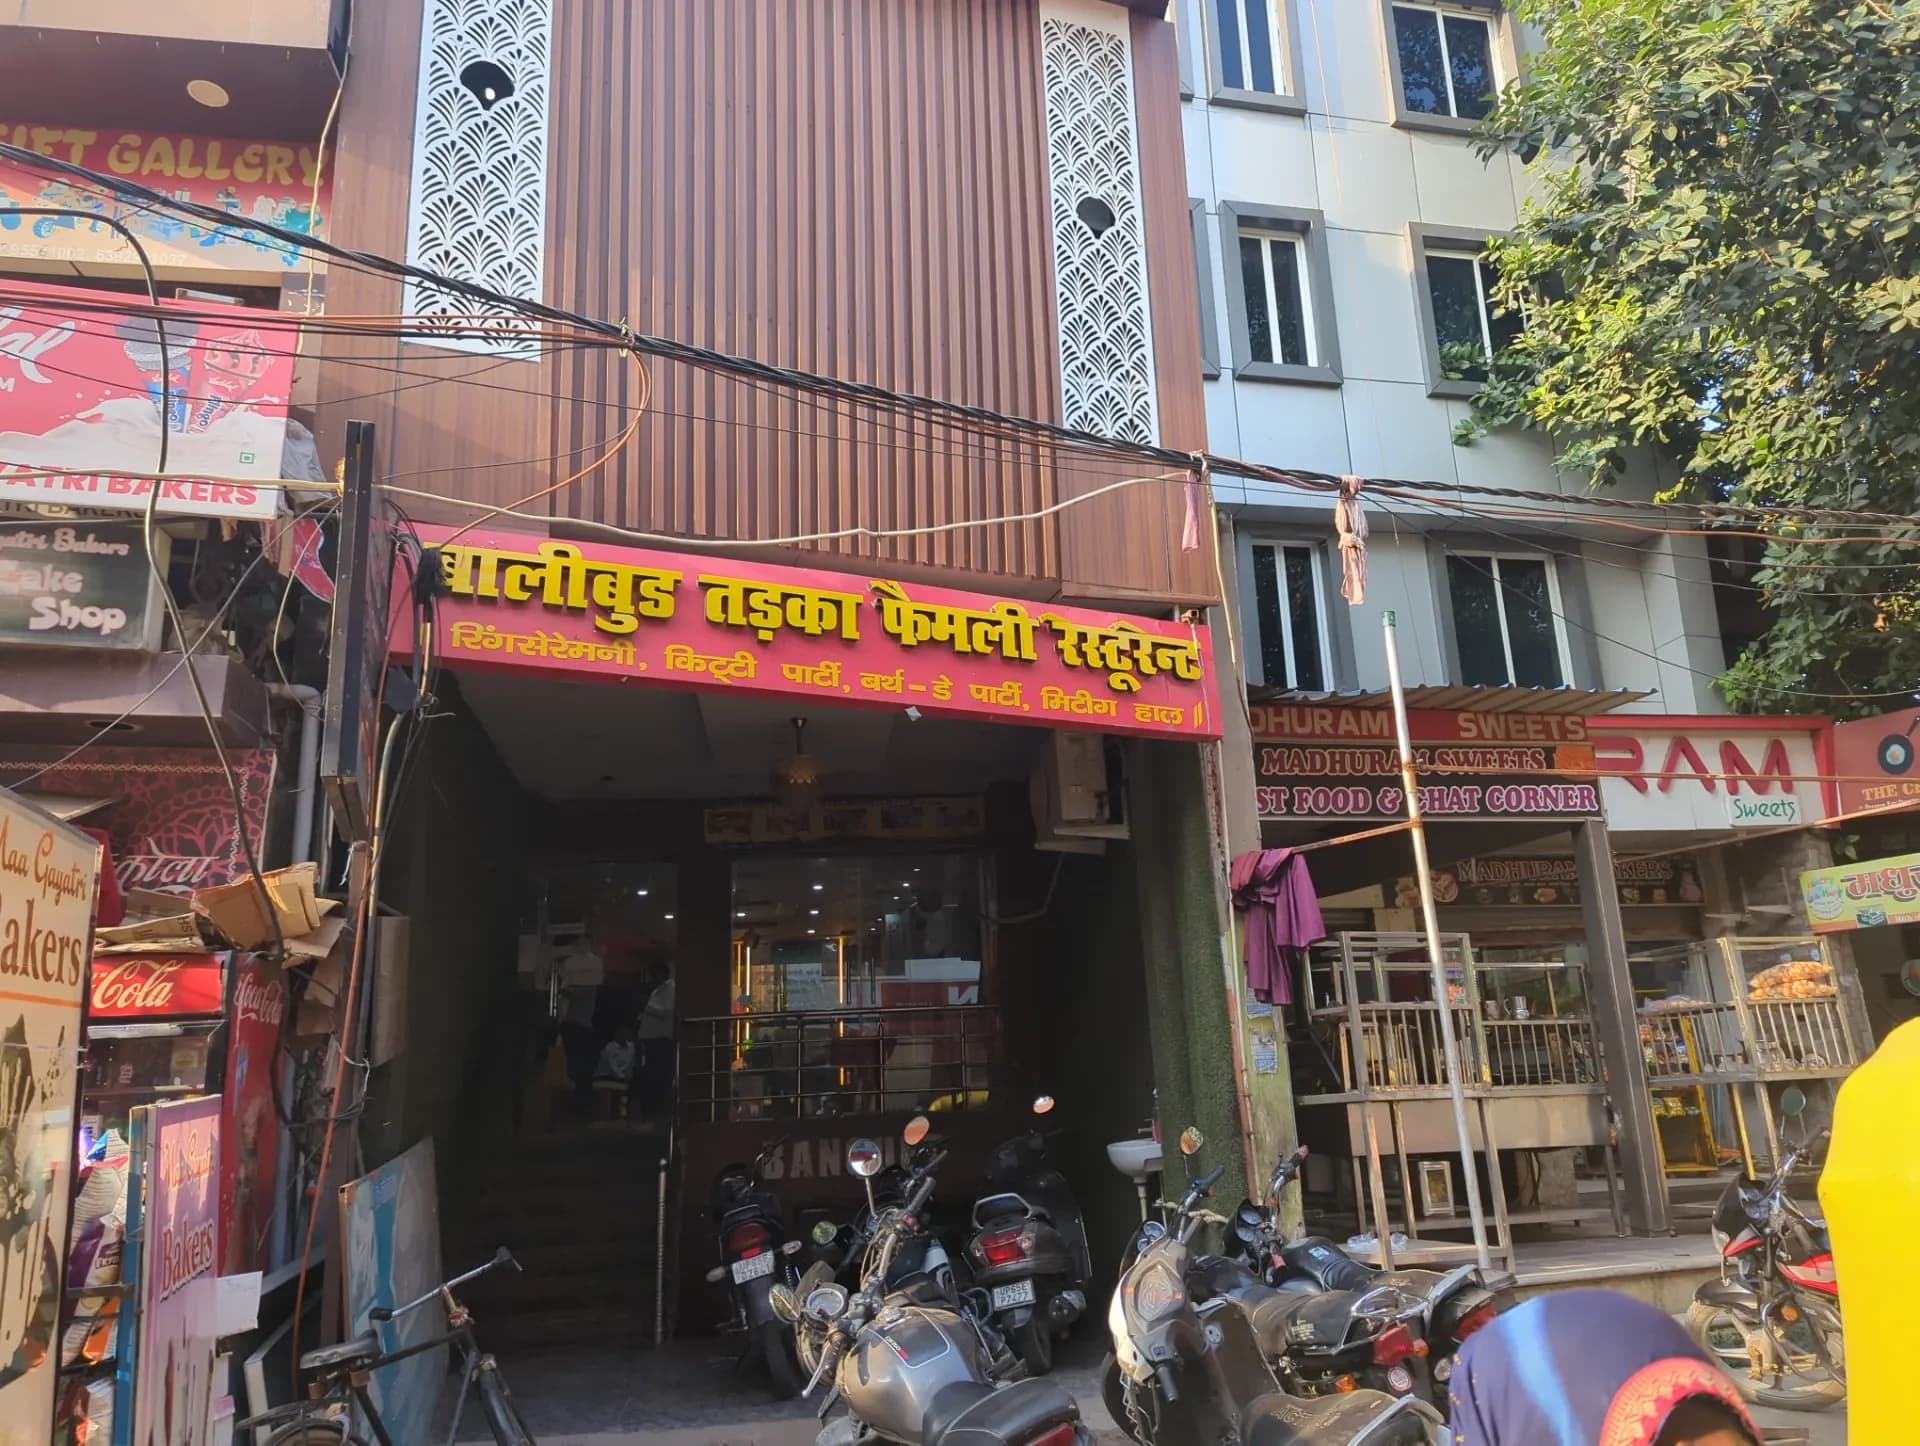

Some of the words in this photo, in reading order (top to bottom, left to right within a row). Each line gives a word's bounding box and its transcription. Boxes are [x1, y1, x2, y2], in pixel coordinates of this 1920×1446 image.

[108, 133, 329, 187] GALLERY
[107, 471, 257, 505] BAKERS
[53, 527, 129, 555] Bakers
[28, 596, 127, 636] Shop
[699, 574, 864, 641] तड़का
[1133, 703, 1184, 725] हाल
[1457, 713, 1586, 740] SWEETS
[1435, 749, 1546, 777] SWEETS
[1294, 786, 1372, 814] FOOD
[1377, 787, 1403, 813] &
[1487, 785, 1598, 812] CORNER
[1861, 784, 1897, 801] THE
[1733, 798, 1796, 822] Sweets
[34, 832, 87, 906] Gayatri
[0, 897, 82, 987] akers
[161, 1221, 214, 1292] Bakers
